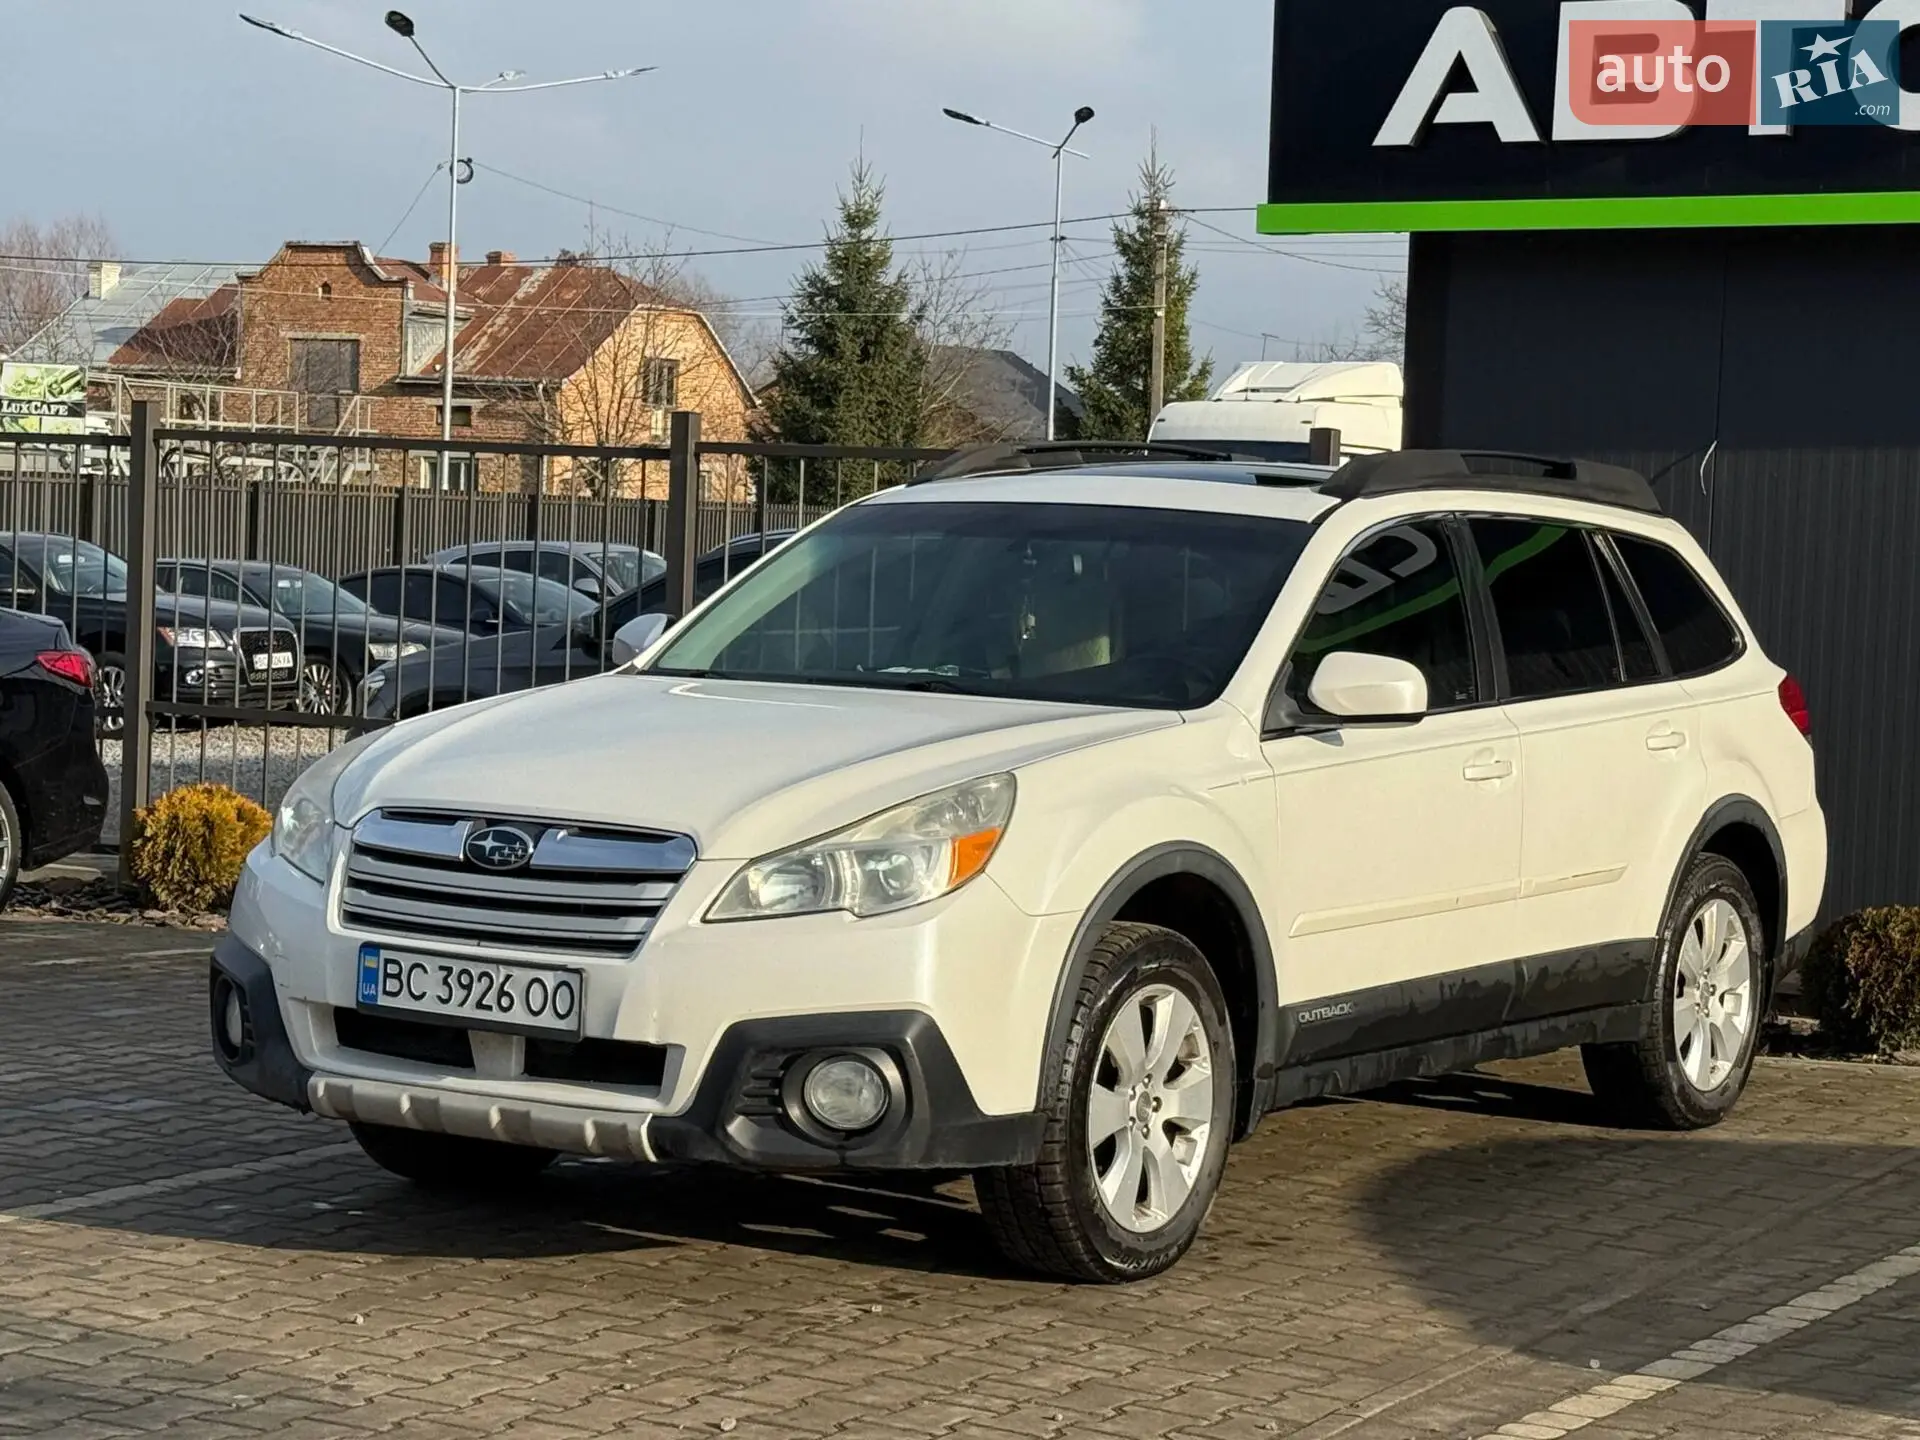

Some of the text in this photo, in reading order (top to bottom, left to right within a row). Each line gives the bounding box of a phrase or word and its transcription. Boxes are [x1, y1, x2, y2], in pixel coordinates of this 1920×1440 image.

[362, 981, 377, 997] UA
[382, 957, 430, 1002] BC
[435, 964, 516, 1014] 3926
[1298, 1001, 1354, 1023] OUTBACK
